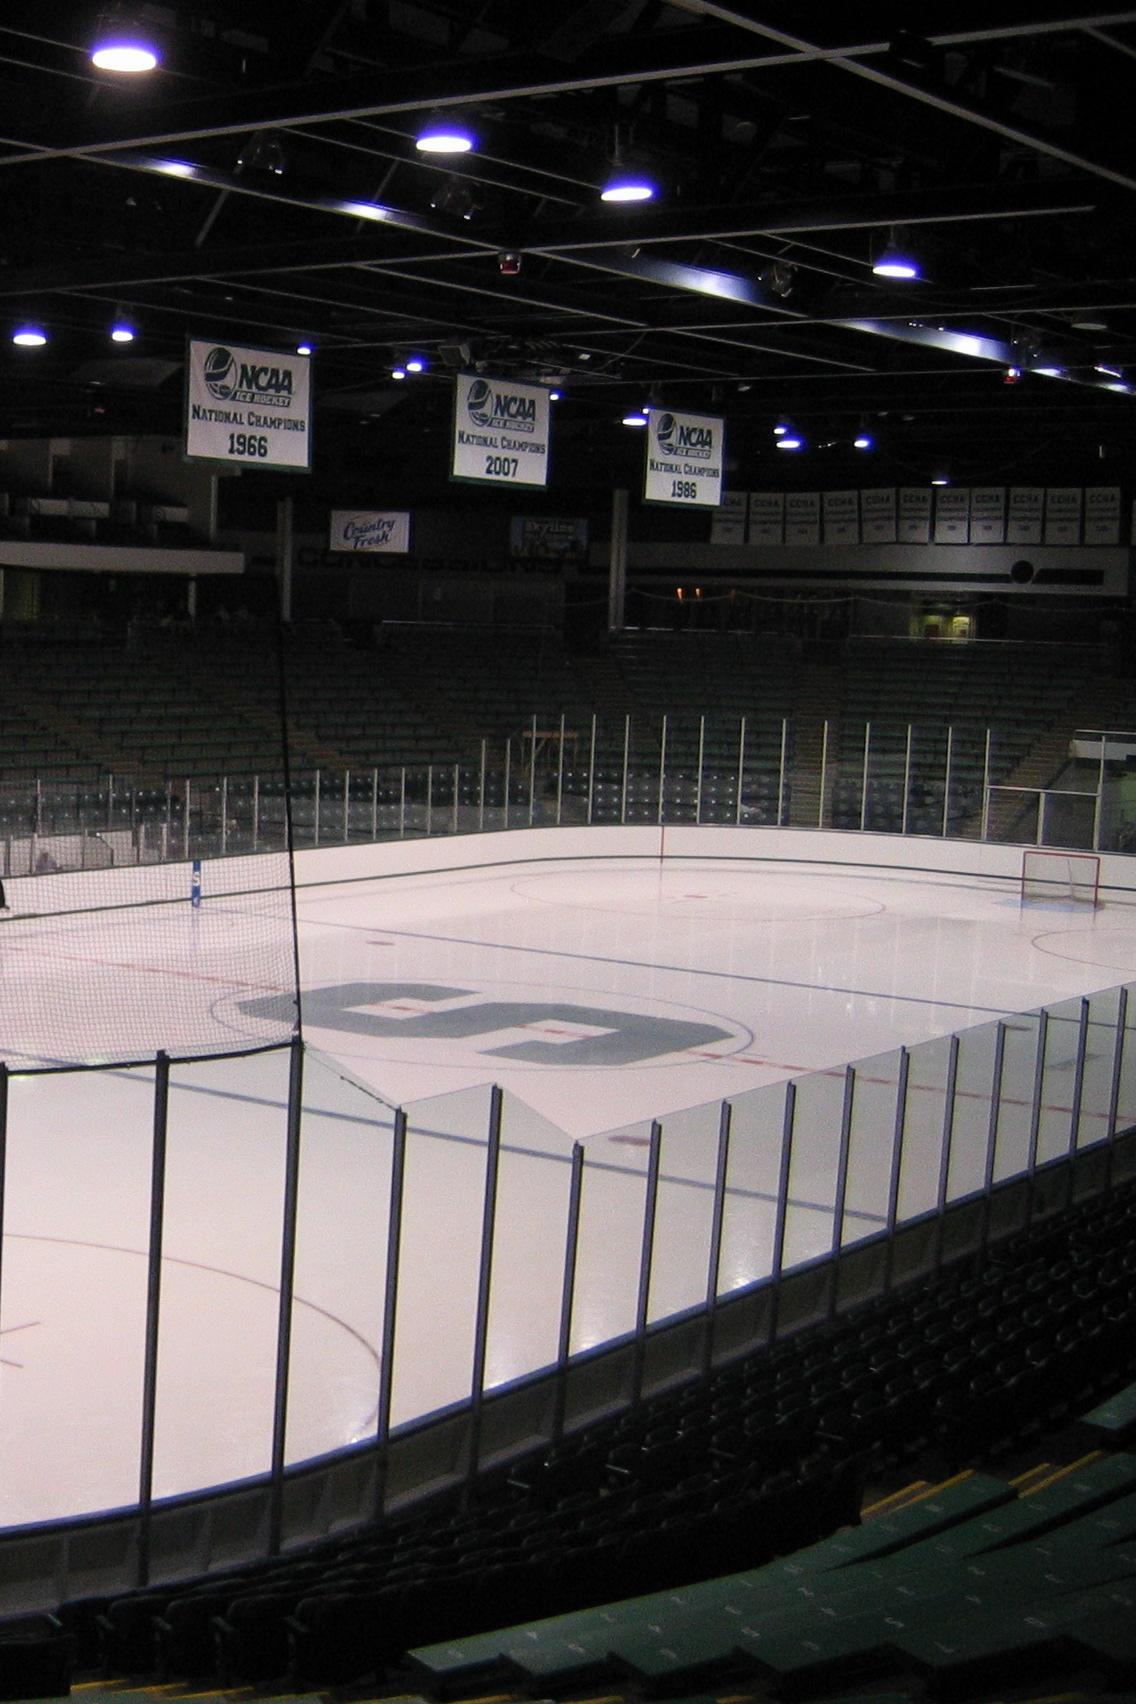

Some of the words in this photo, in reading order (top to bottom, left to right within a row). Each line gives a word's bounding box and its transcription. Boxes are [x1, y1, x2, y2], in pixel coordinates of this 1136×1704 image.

[239, 364, 293, 395] NCAA
[235, 391, 253, 403] ICE
[253, 393, 290, 408] HOCKEY
[494, 395, 536, 421] NCAA
[228, 432, 268, 457] 1966
[678, 425, 713, 449] NCAA
[485, 455, 519, 478] 2007
[671, 479, 697, 499] 1986
[343, 518, 396, 541] Country
[353, 530, 390, 551] Fresh
